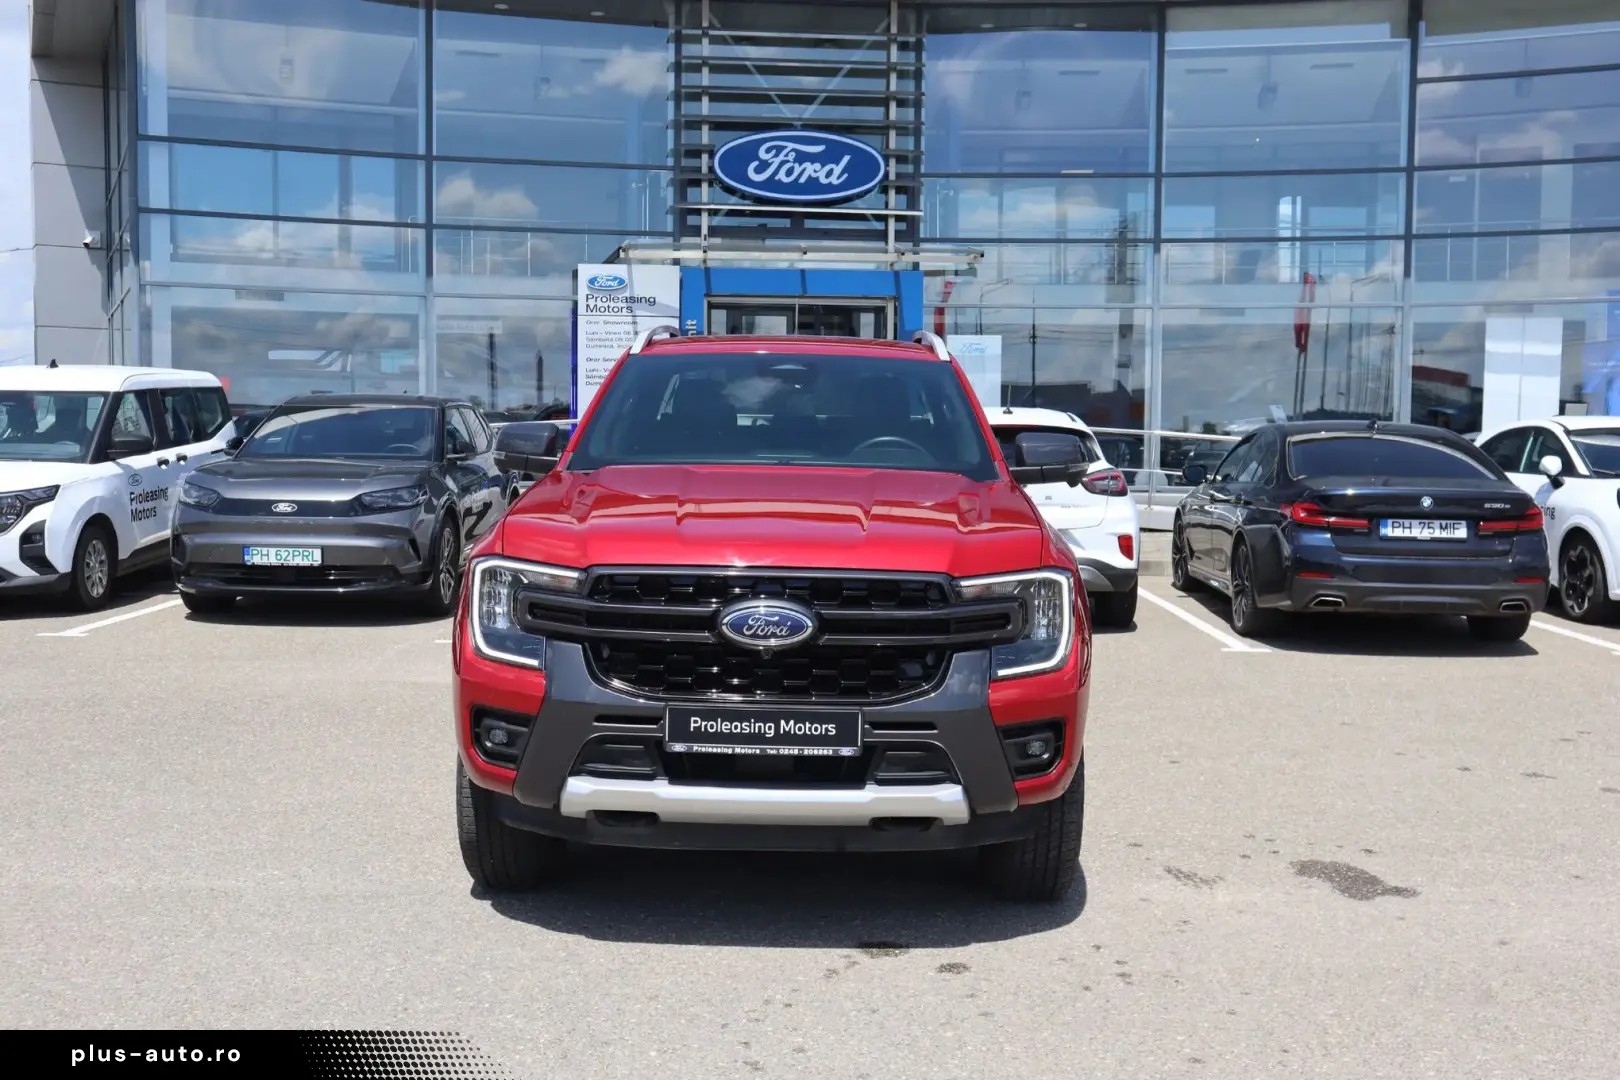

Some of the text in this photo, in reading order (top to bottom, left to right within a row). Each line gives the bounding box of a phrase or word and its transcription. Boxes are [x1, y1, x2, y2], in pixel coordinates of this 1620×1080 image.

[747, 140, 851, 185] Ford
[594, 275, 620, 287] Ford
[585, 293, 657, 307] Proleasing
[585, 303, 634, 314] Motors
[129, 485, 169, 506] Proleasing
[130, 506, 157, 522] Motors
[1391, 520, 1462, 536] PH 75 MIF
[250, 548, 320, 562] PH 62PRL
[743, 614, 792, 636] Ford
[690, 716, 836, 738] Proleasing Motors
[692, 745, 733, 754] Proleasing
